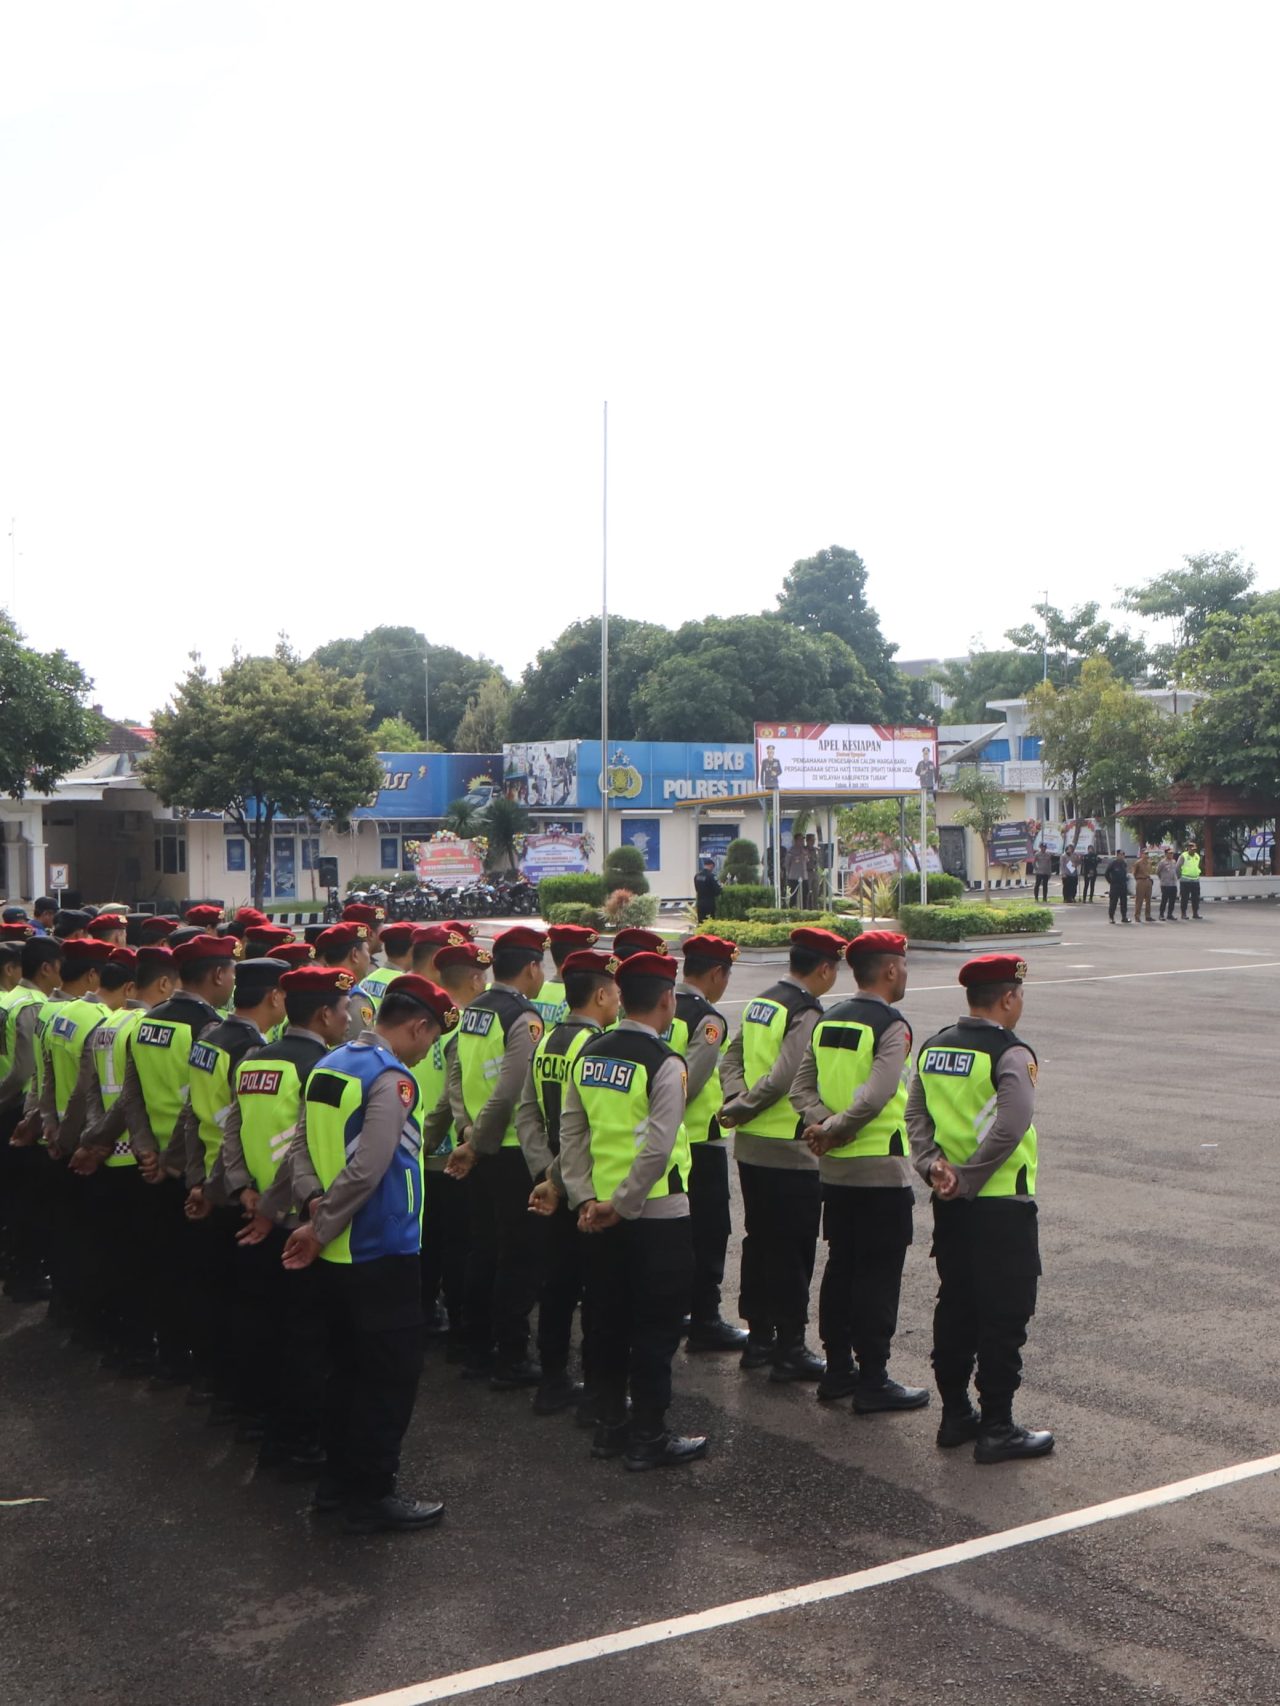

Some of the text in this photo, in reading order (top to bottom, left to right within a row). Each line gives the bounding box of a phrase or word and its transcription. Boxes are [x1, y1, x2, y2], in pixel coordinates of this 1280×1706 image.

[818, 740, 882, 752] APEL KESIAPAN
[703, 751, 744, 770] BPKB
[663, 780, 728, 799] POLRES
[139, 1024, 171, 1044] POLISI
[925, 1053, 976, 1073] POLISI
[240, 1073, 278, 1091] POLISI
[582, 1061, 632, 1088] POLISI
